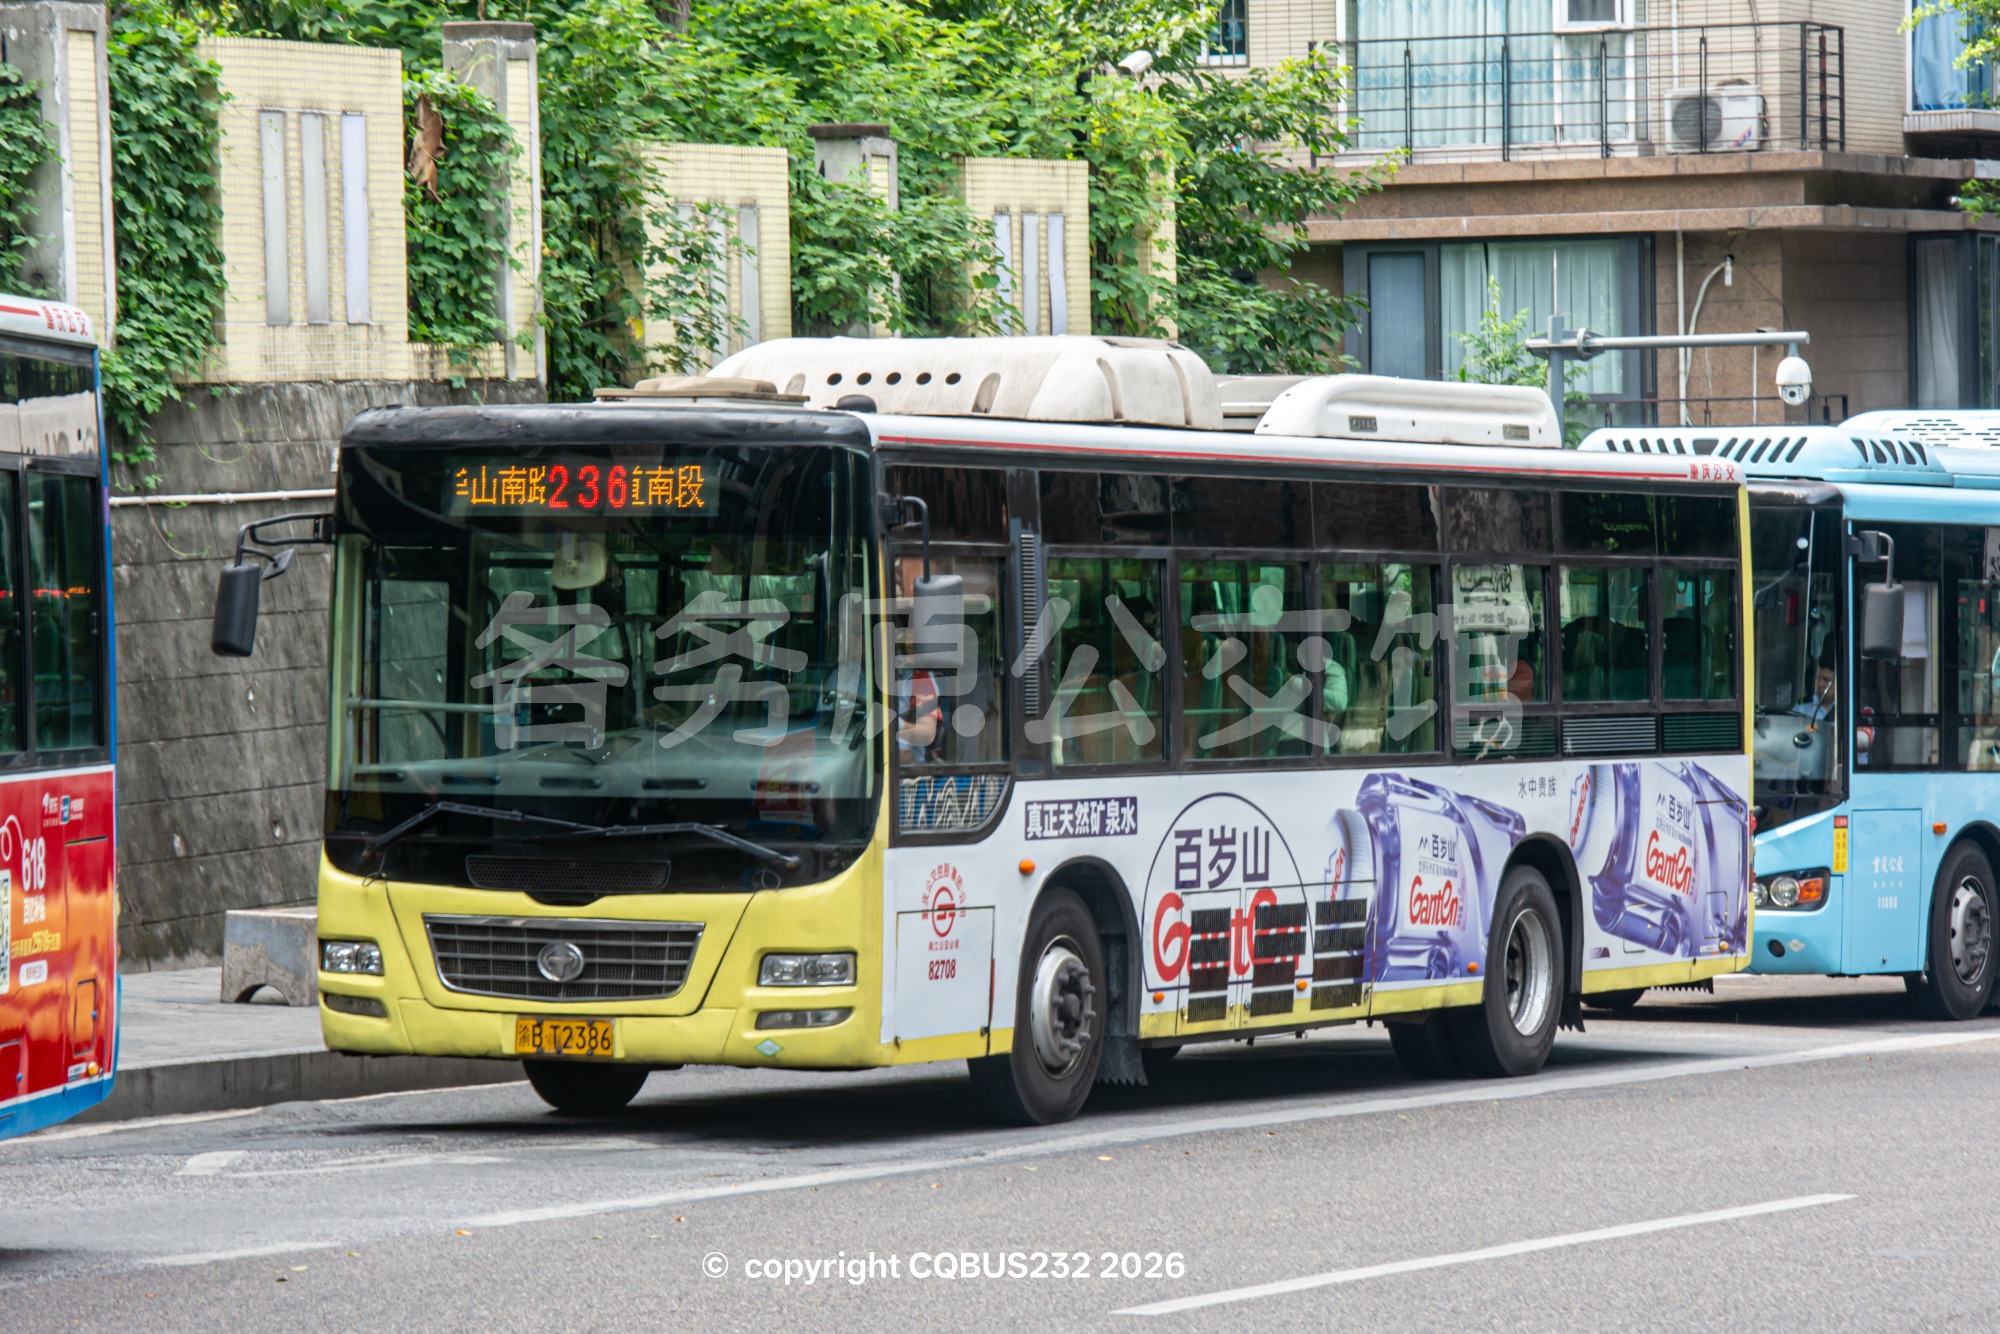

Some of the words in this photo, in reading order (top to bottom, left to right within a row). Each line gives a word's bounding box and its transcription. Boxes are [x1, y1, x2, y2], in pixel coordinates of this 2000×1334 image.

[549, 465, 628, 508] 236
[1689, 463, 1735, 481] 重庆公交
[1518, 776, 1557, 799] 水中贵族
[1027, 798, 1137, 840] 真正天然矿泉水
[1669, 794, 1692, 831] 百岁山
[22, 836, 46, 892] 618
[1174, 825, 1271, 890] 百岁山
[1432, 833, 1457, 862] 百岁山
[1645, 829, 1693, 895] Ganten
[1409, 874, 1459, 927] Ganten
[928, 959, 956, 981] 82708
